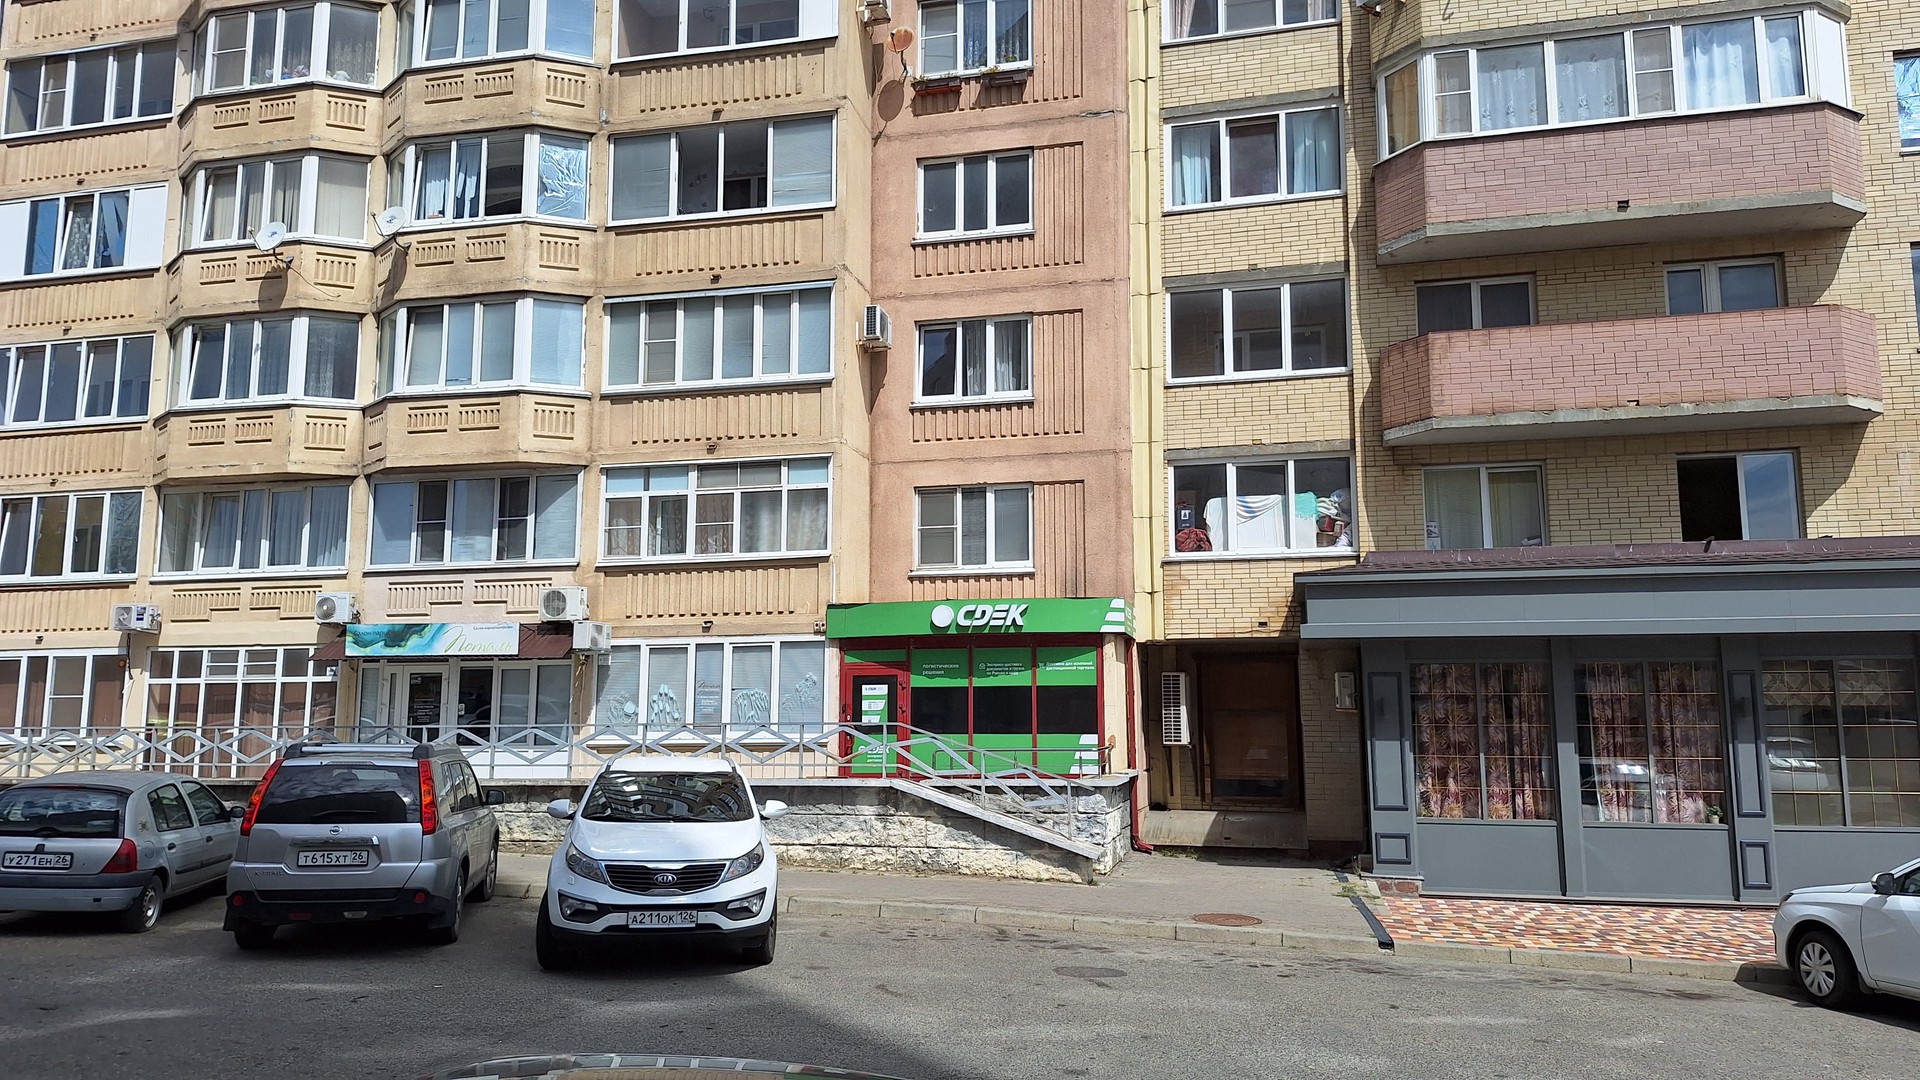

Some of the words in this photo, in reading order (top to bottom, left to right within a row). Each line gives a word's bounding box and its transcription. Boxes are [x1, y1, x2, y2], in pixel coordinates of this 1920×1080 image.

[956, 603, 1029, 626] CDEK
[55, 855, 68, 863] 26
[303, 852, 349, 864] Т615ХТ
[351, 851, 364, 860] 26
[657, 875, 673, 883] KIA
[678, 911, 694, 920] 126
